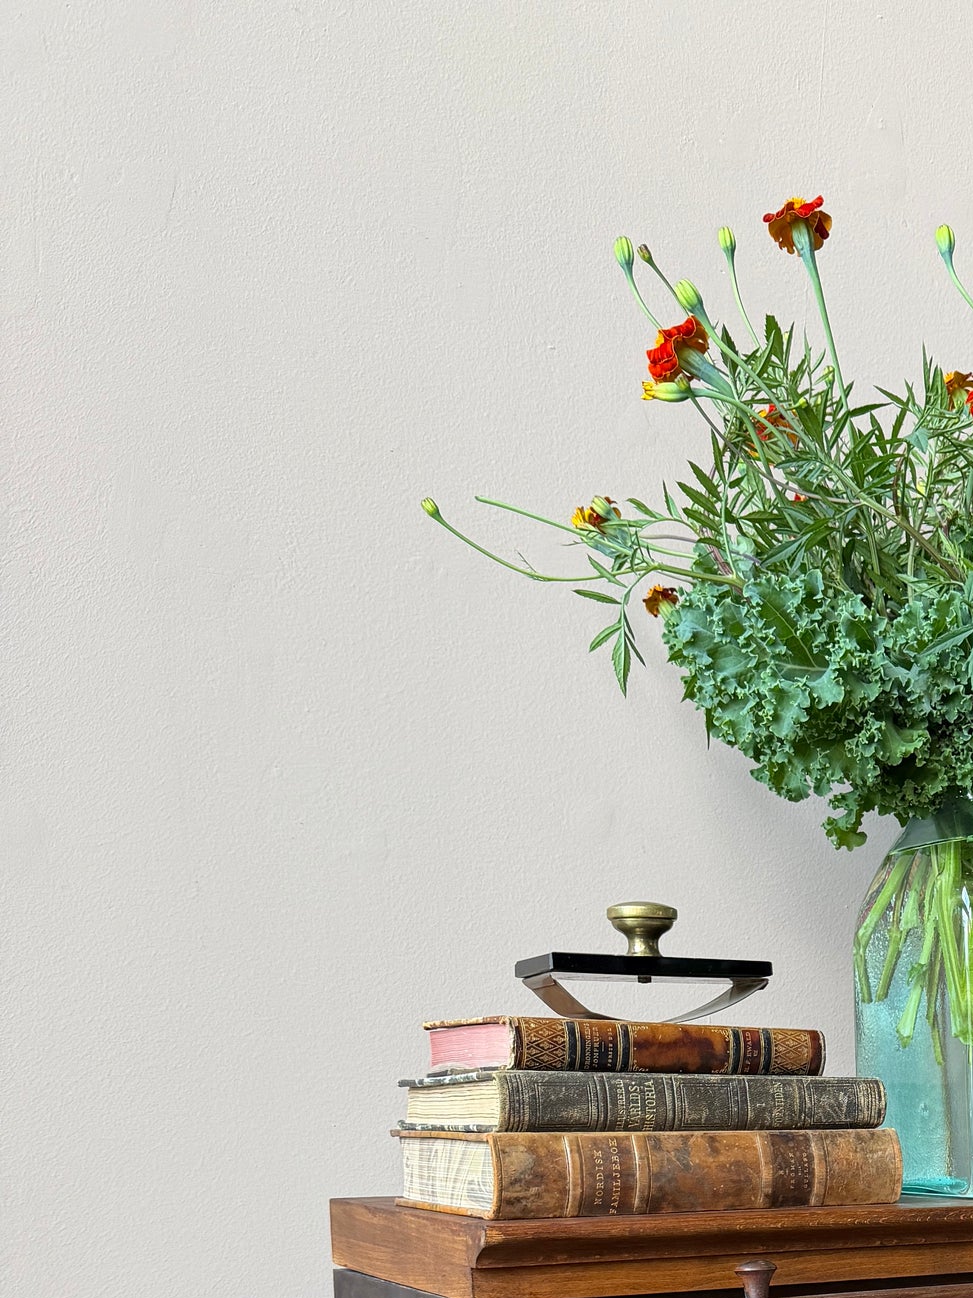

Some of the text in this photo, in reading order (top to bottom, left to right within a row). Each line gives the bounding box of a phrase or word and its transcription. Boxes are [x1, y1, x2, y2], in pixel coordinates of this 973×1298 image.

[642, 1079, 656, 1132] HISTORIA
[593, 1150, 605, 1205] NORDISK
[609, 1138, 621, 1214] FAMILJEBOK
